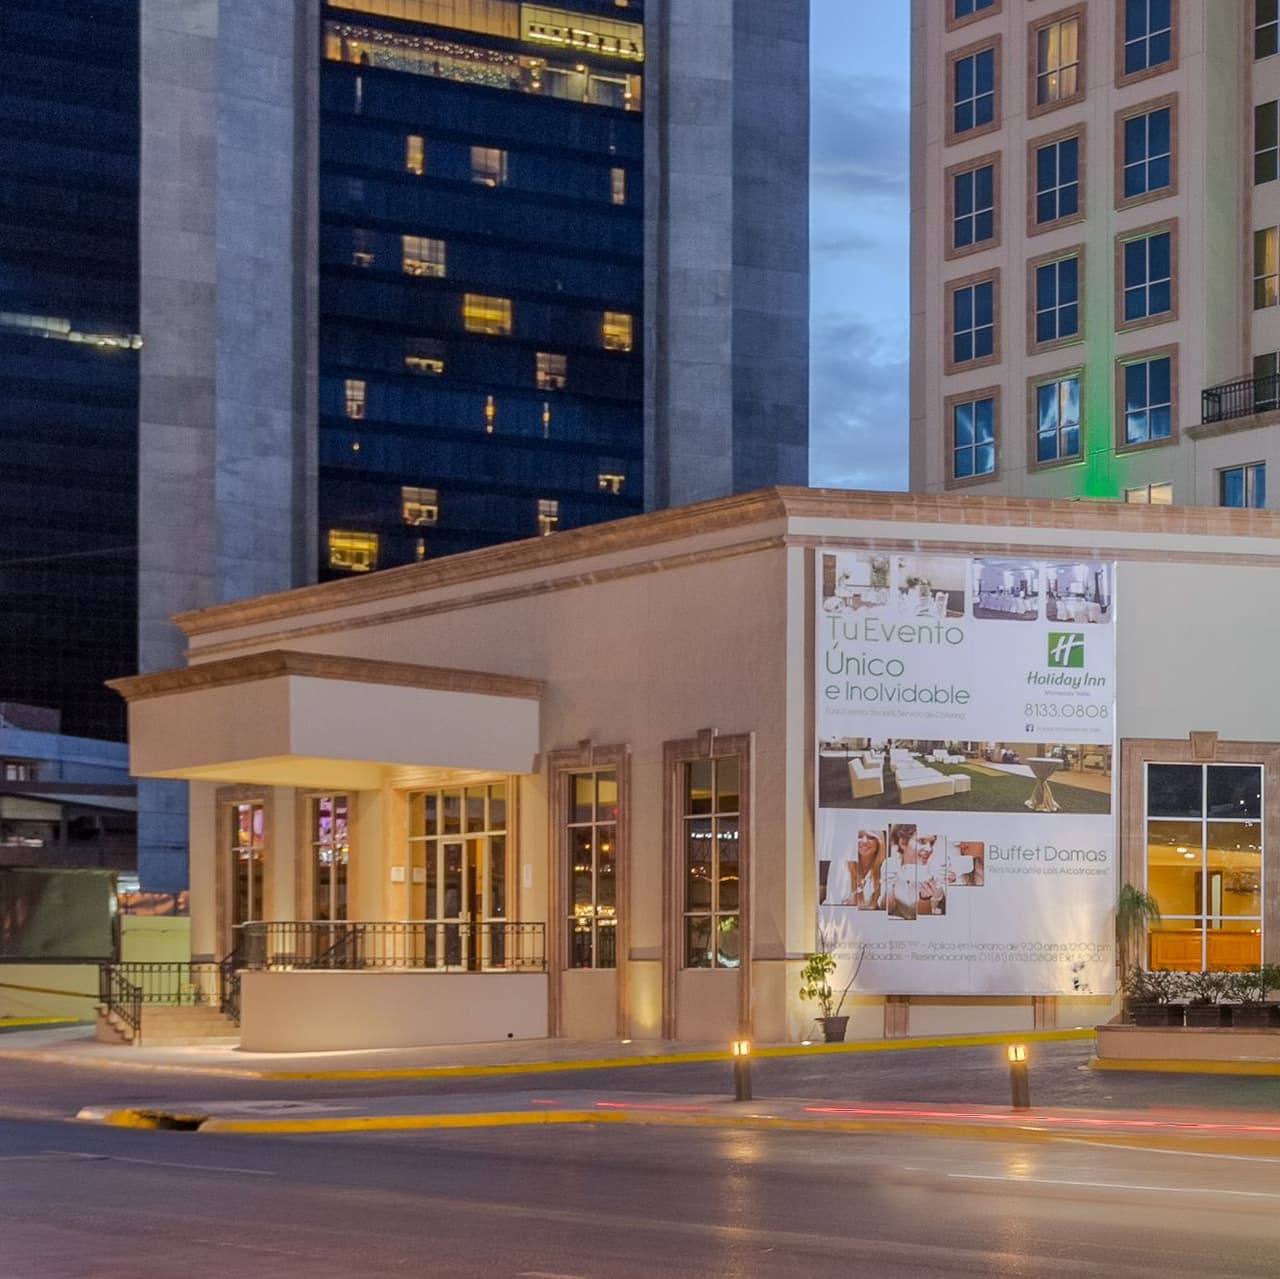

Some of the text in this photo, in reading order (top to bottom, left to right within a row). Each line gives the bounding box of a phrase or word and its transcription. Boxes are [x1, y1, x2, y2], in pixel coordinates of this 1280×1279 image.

[826, 615, 964, 645] Tu Evento
[825, 642, 905, 677] Único
[1027, 671, 1106, 689] Holiday Inn
[825, 681, 970, 705] e Inolvidable
[1024, 703, 1108, 718] 8133.0808
[988, 845, 1108, 862] Buffet Damas
